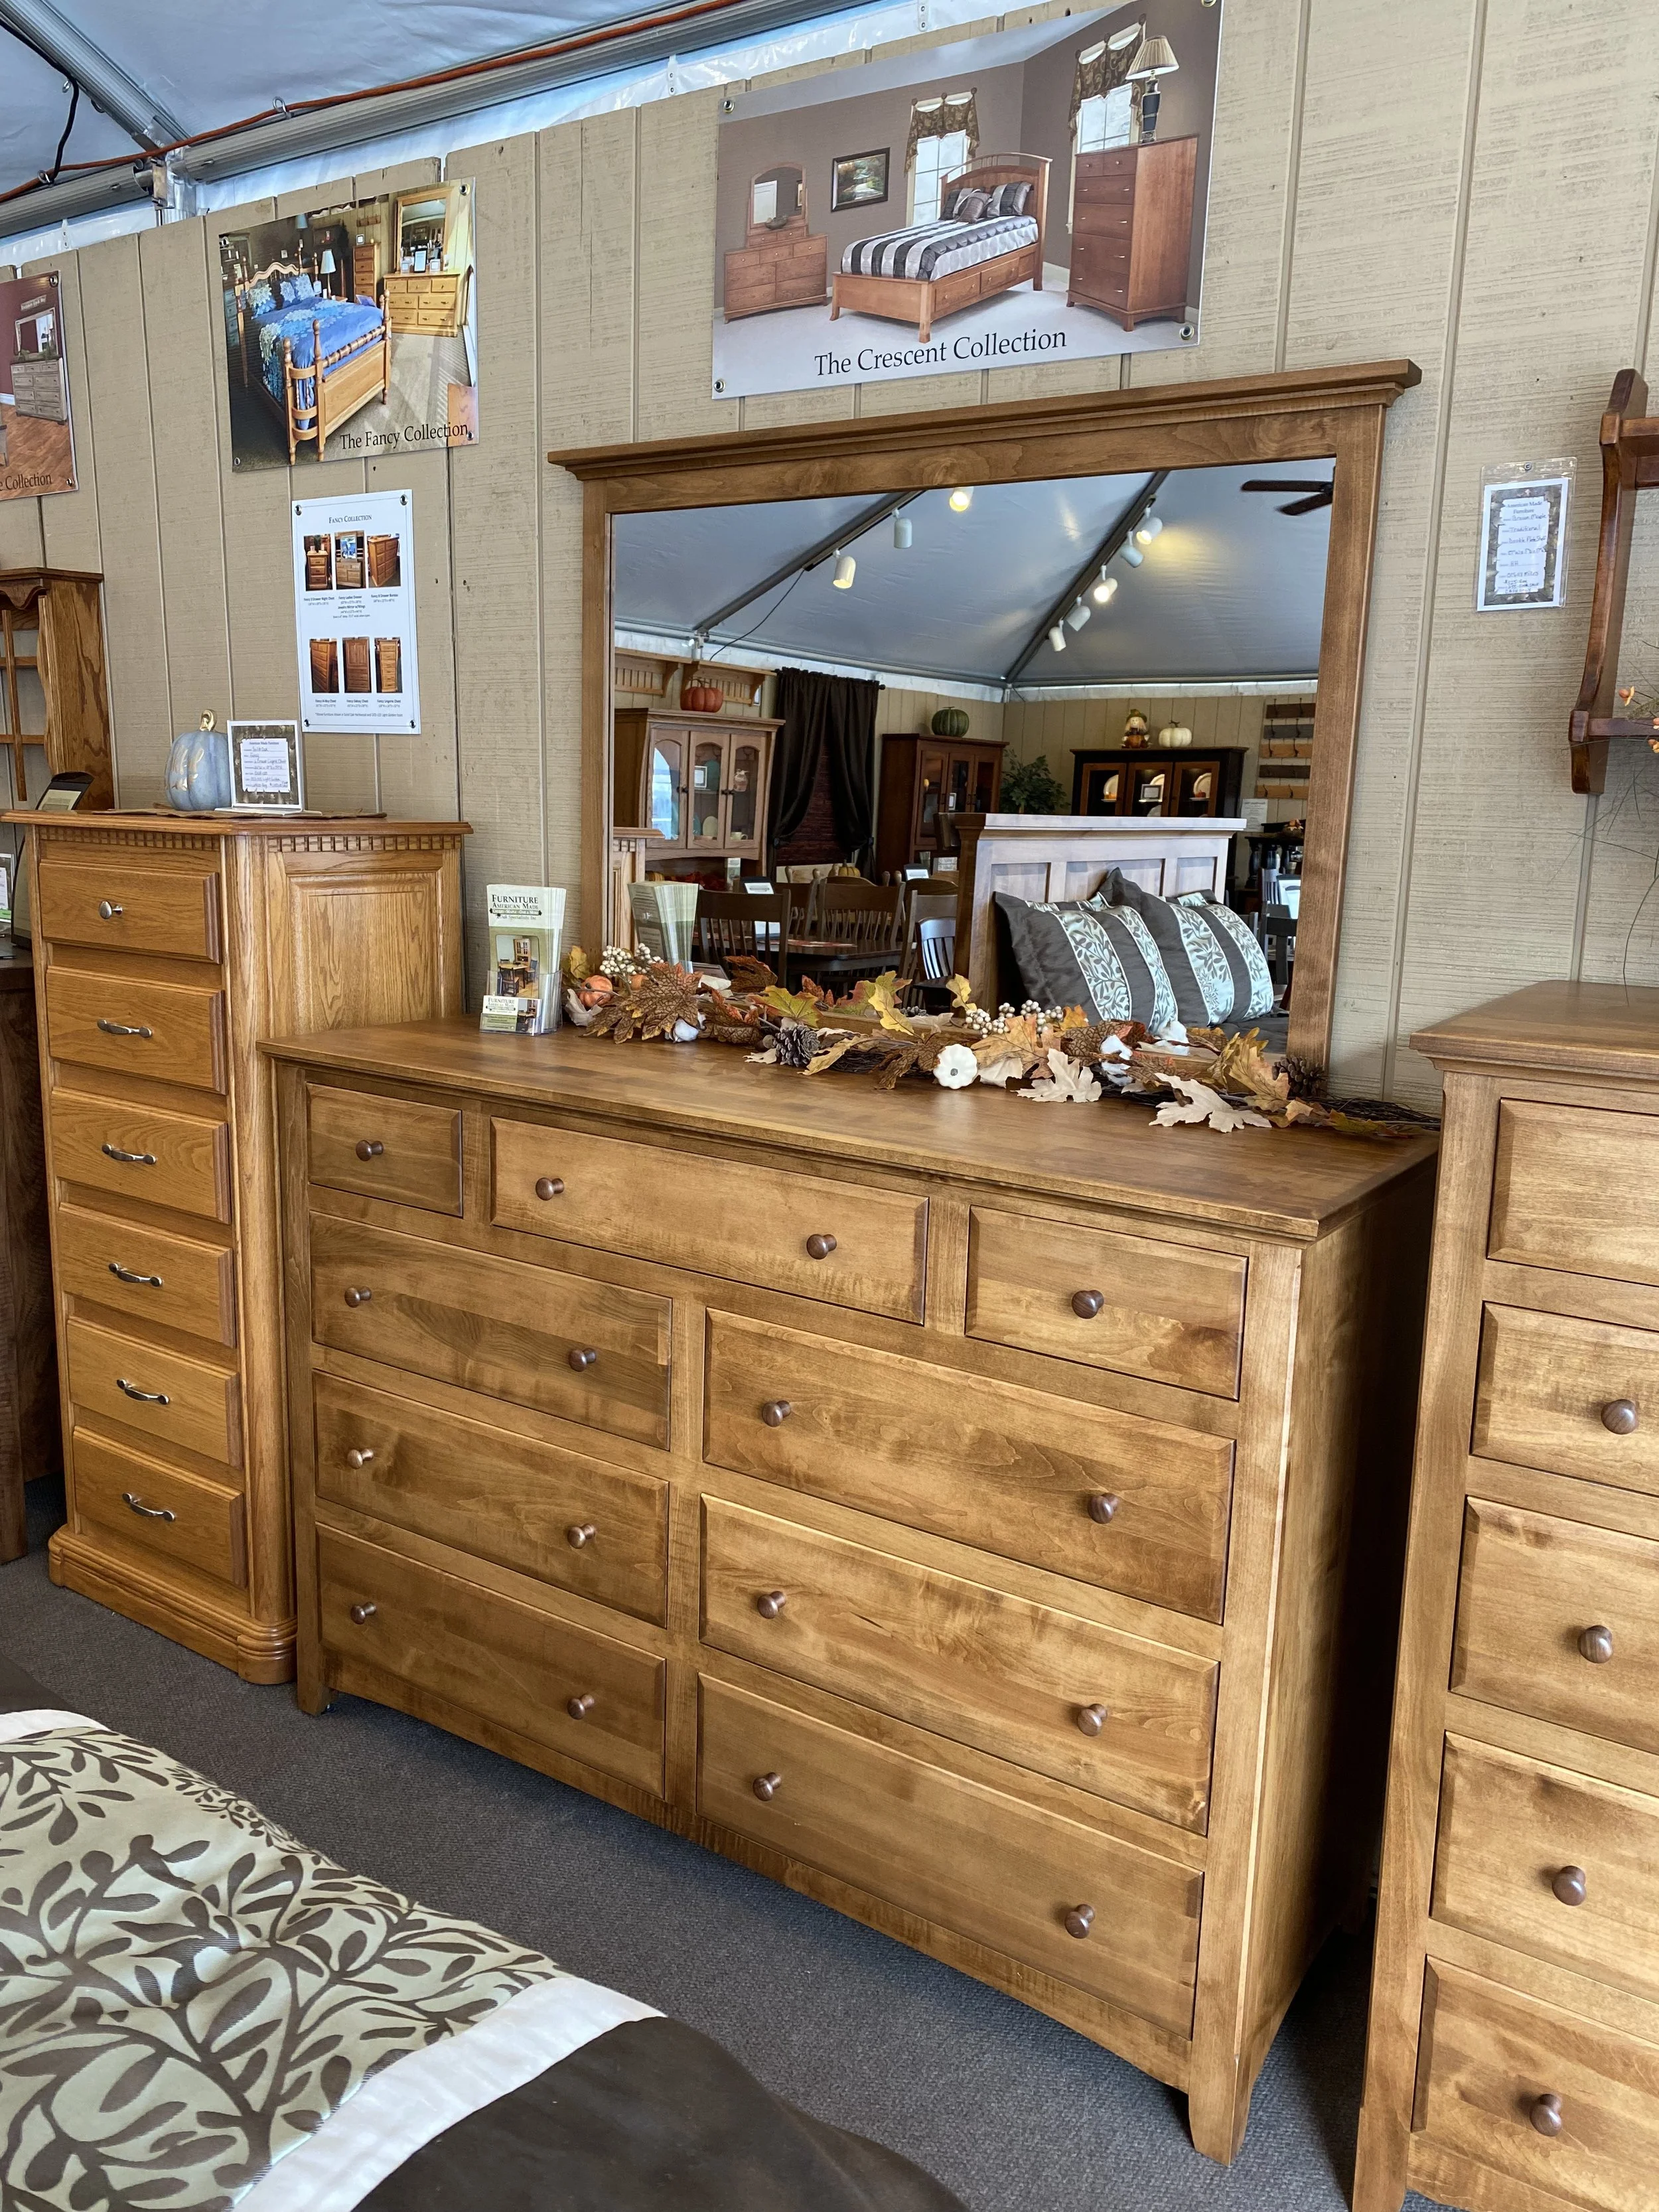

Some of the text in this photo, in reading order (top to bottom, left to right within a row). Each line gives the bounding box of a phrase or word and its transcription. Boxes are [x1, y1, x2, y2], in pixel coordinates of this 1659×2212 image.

[814, 329, 1067, 376] The Crescent Collection
[340, 421, 469, 449] The Fancy Collection
[5, 472, 52, 490] Collection
[1508, 524, 1541, 533] Traditional
[492, 895, 538, 904] FURNITURE
